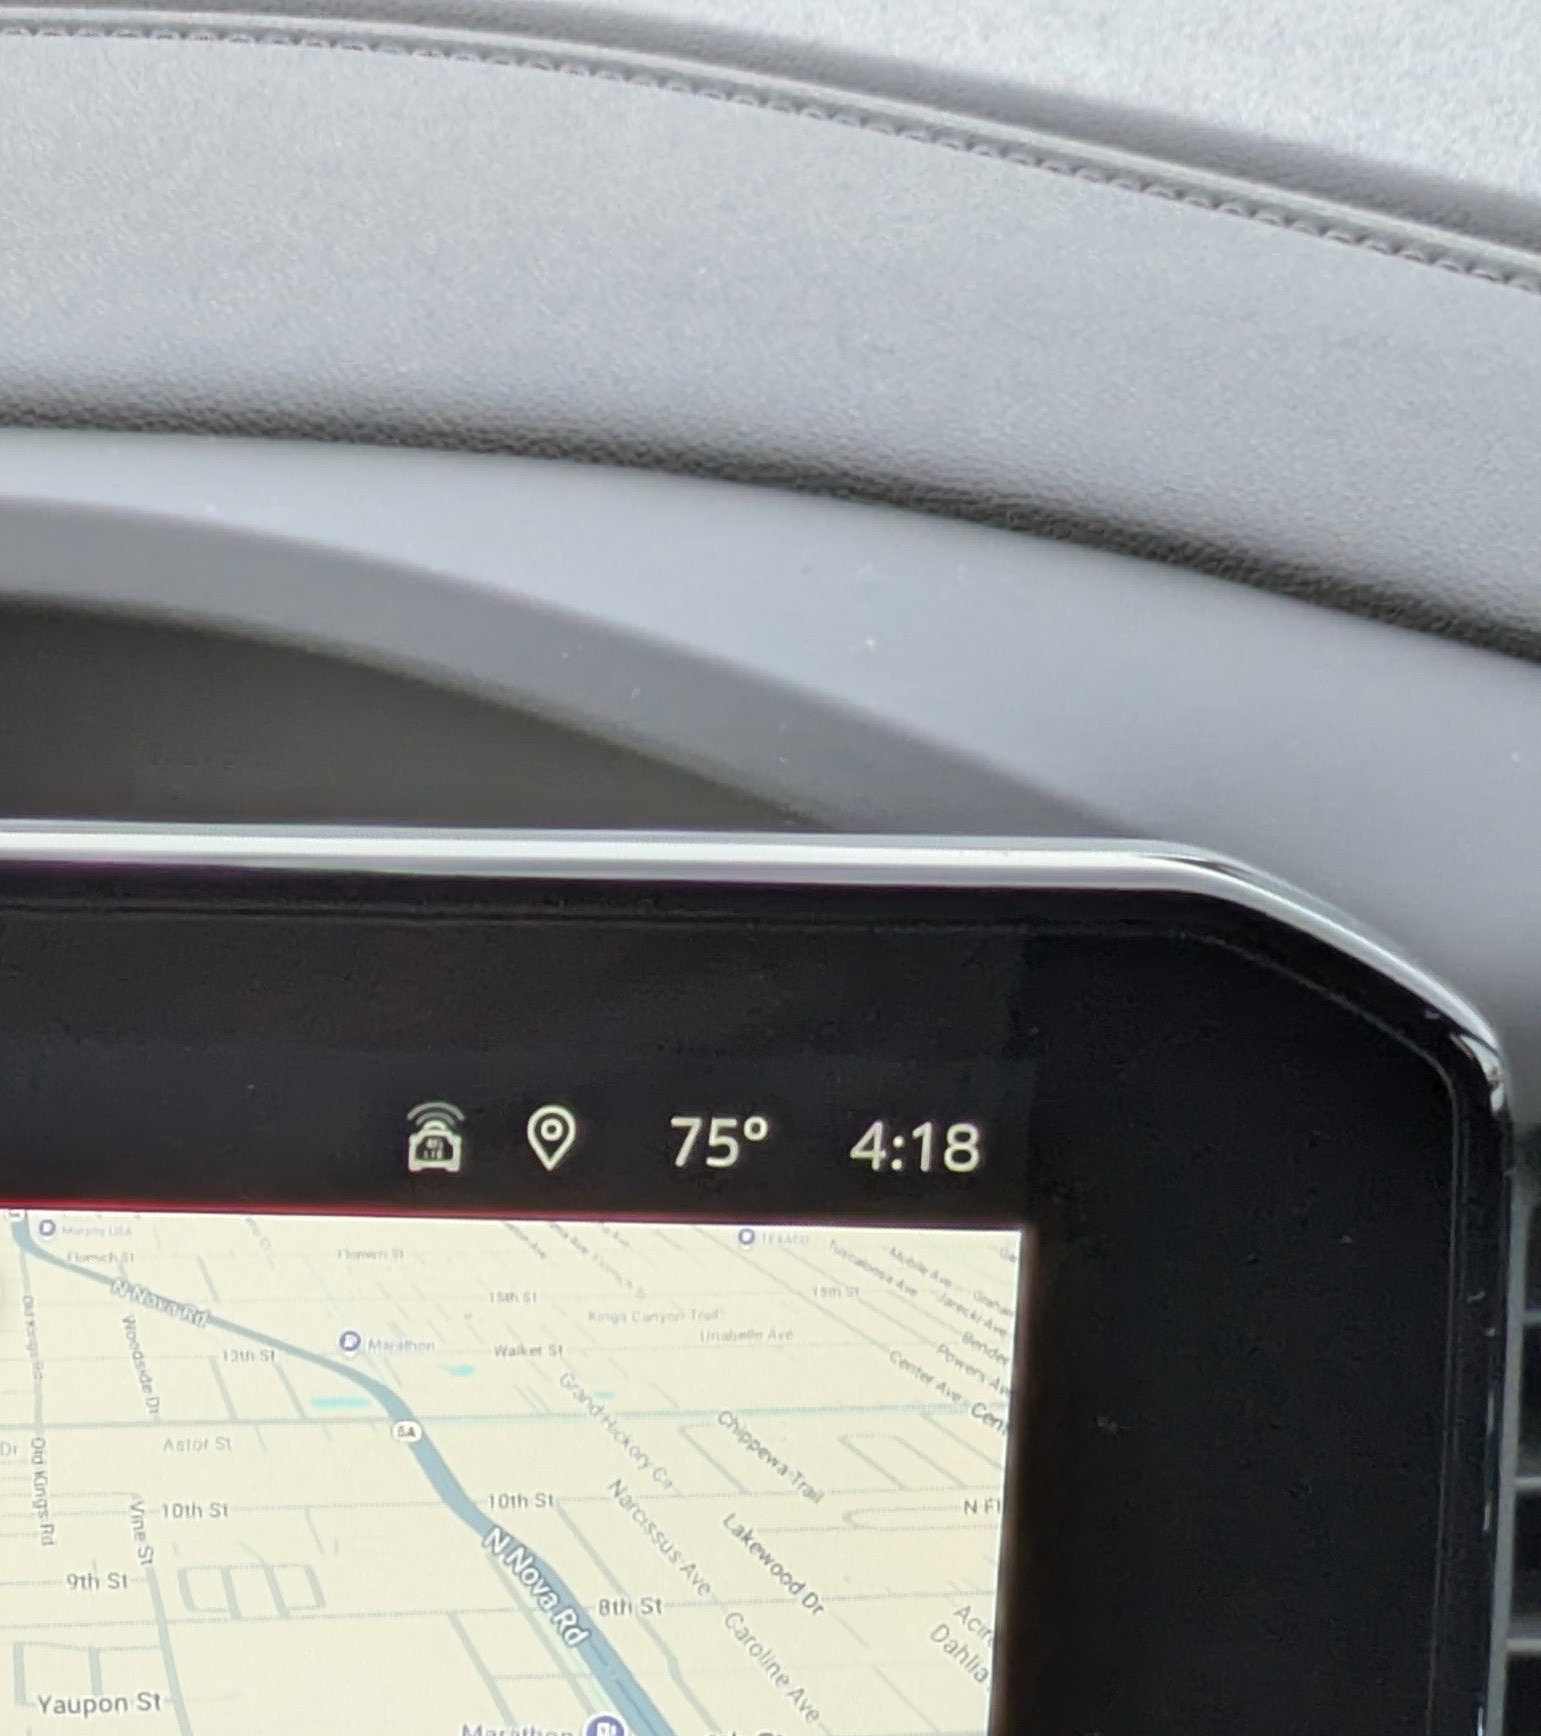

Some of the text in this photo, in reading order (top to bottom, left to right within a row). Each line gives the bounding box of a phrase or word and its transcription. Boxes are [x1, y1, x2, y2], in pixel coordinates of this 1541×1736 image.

[670, 1116, 769, 1168] 75°
[850, 1120, 980, 1172] 4:18
[162, 1501, 230, 1520] 10th St
[488, 1492, 555, 1510] 10th St
[137, 1545, 155, 1567] St
[721, 1511, 826, 1617] Lakewood Dr
[66, 1572, 128, 1591] 9th St
[482, 1526, 591, 1647] N Nova Rd
[679, 1562, 712, 1598] Ave
[598, 1596, 663, 1616] 8th St
[724, 1611, 820, 1723] Caroline Ave
[930, 1623, 990, 1684] Dahlia
[37, 1691, 163, 1718] Yaupon St
